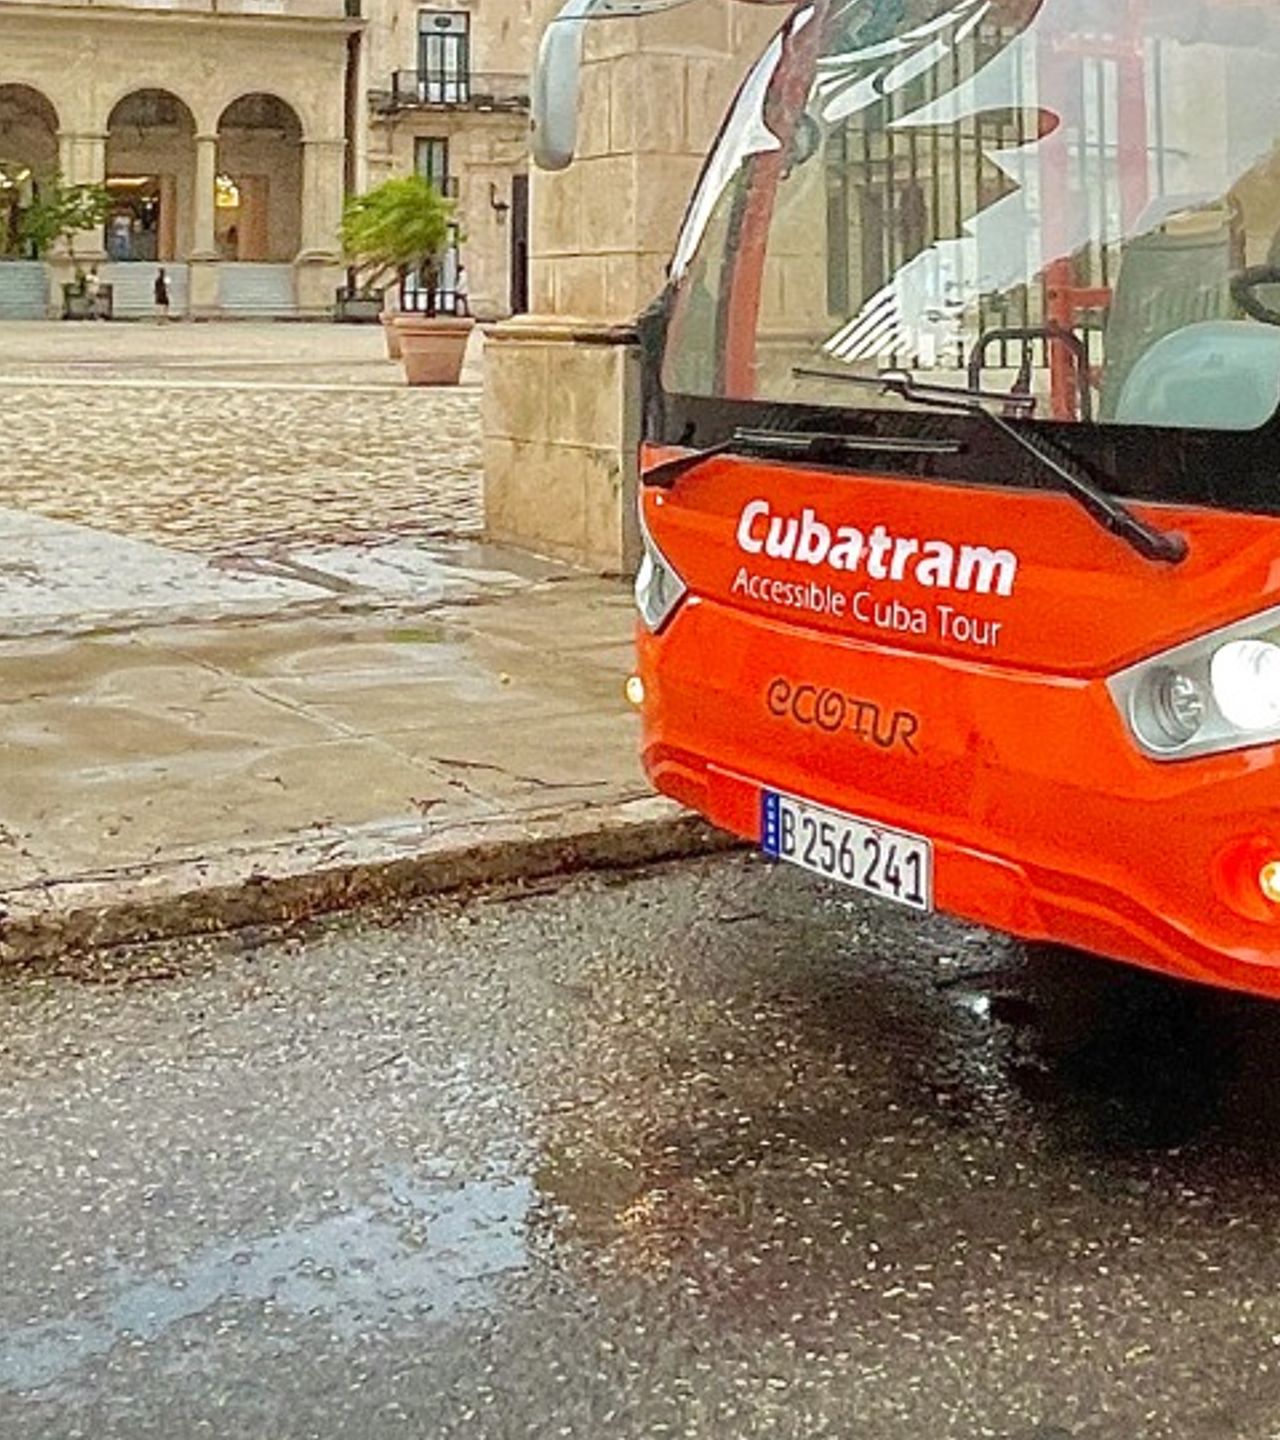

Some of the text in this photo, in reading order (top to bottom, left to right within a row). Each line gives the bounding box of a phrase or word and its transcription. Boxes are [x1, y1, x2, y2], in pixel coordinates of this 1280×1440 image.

[736, 499, 1018, 596] Cubatram
[732, 567, 1002, 646] Accessible Cuba Tour
[863, 836, 924, 905] 241
